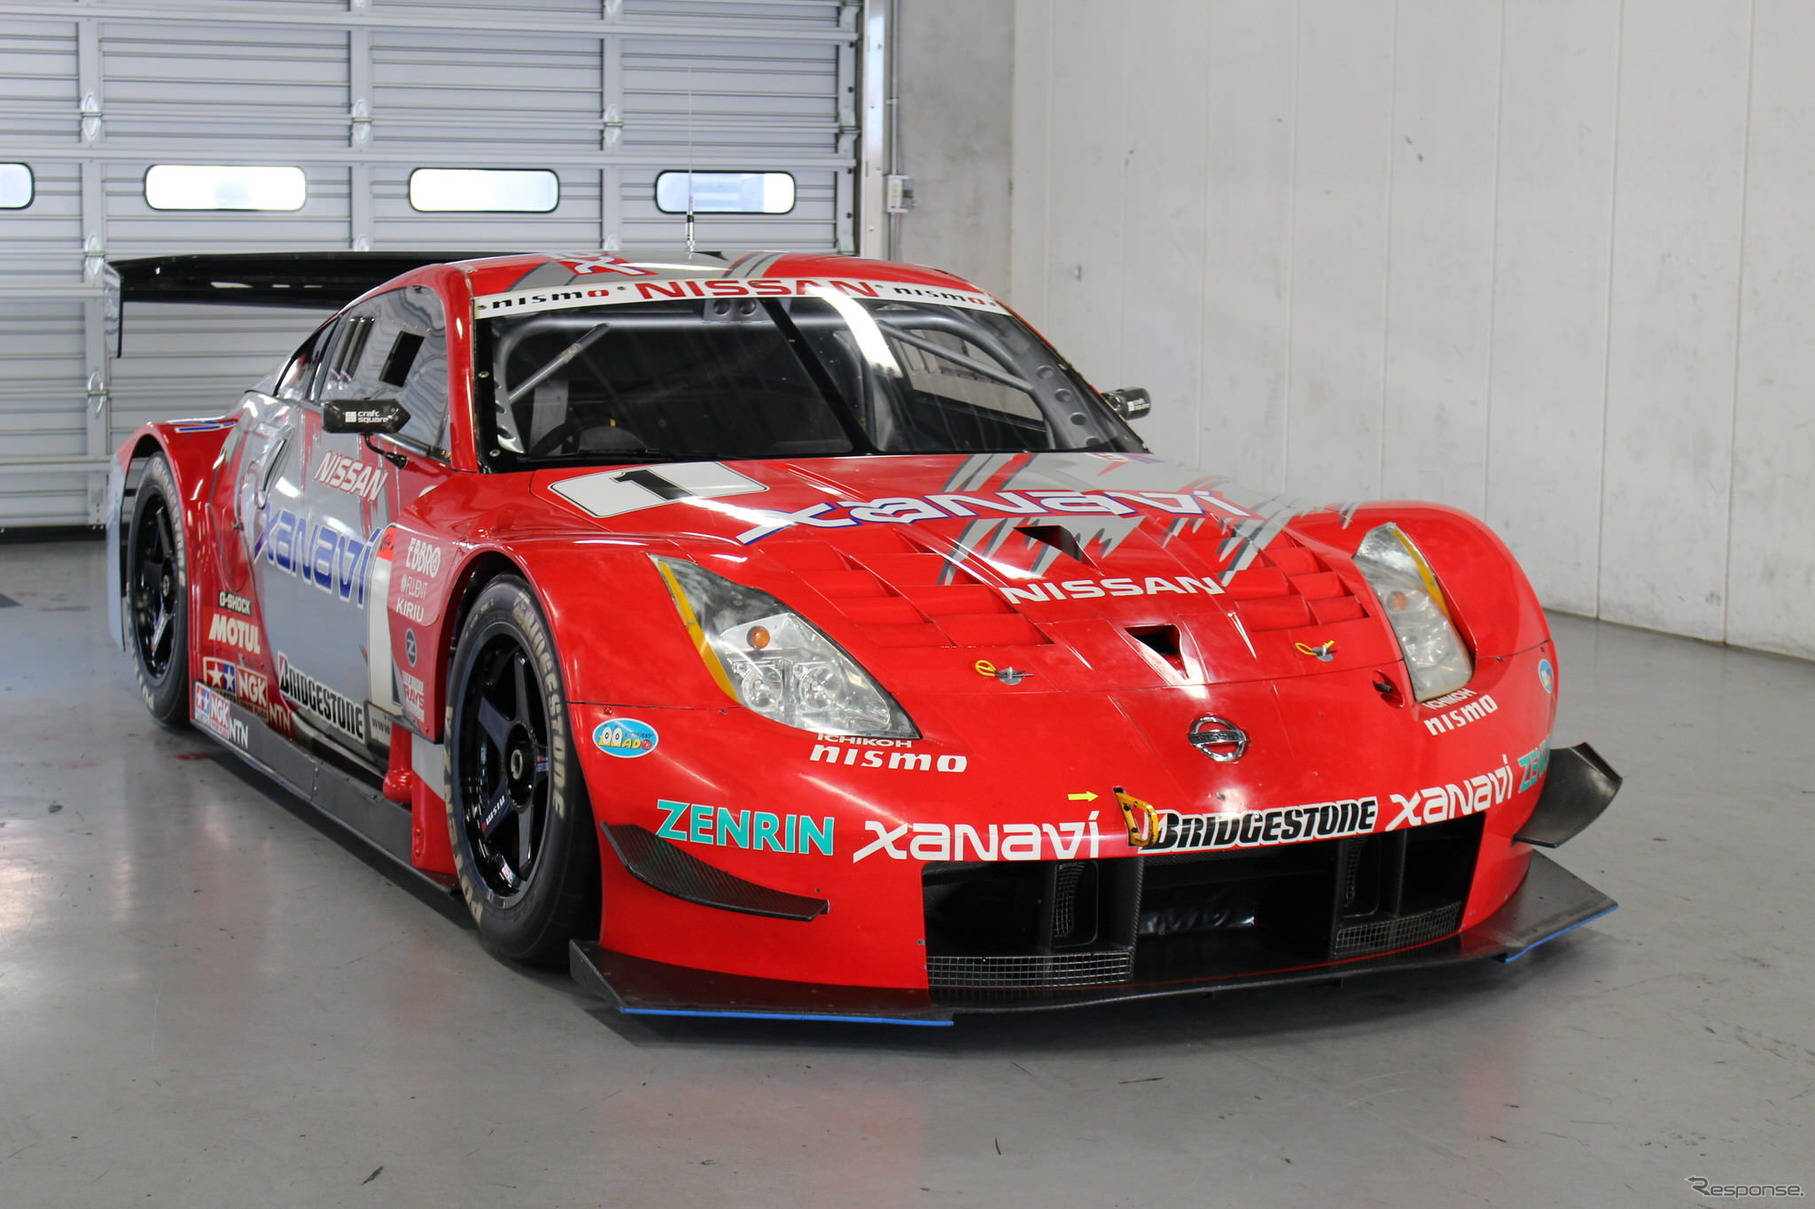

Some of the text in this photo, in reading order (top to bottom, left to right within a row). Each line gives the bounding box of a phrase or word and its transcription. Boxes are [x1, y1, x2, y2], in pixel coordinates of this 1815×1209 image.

[492, 279, 986, 309] nismo NISSAN nismo
[357, 409, 380, 417] craft
[357, 415, 390, 424] square
[312, 450, 389, 501] NISSAN
[615, 469, 696, 501] 1
[997, 574, 1226, 606] NISSAN
[395, 597, 425, 622] KIRIU
[208, 613, 261, 655] MOTUL
[236, 670, 268, 708] NGK
[278, 651, 367, 744] BRIDGESTONE
[210, 692, 230, 729] NGK
[268, 701, 291, 733] NTN
[1423, 694, 1499, 737] nismo
[229, 717, 249, 750] NTN
[816, 732, 913, 749] ICHIKOH
[809, 743, 968, 773] nismo
[655, 798, 835, 857] ZENRIN
[1137, 796, 1379, 854] BRIDGESTONE
